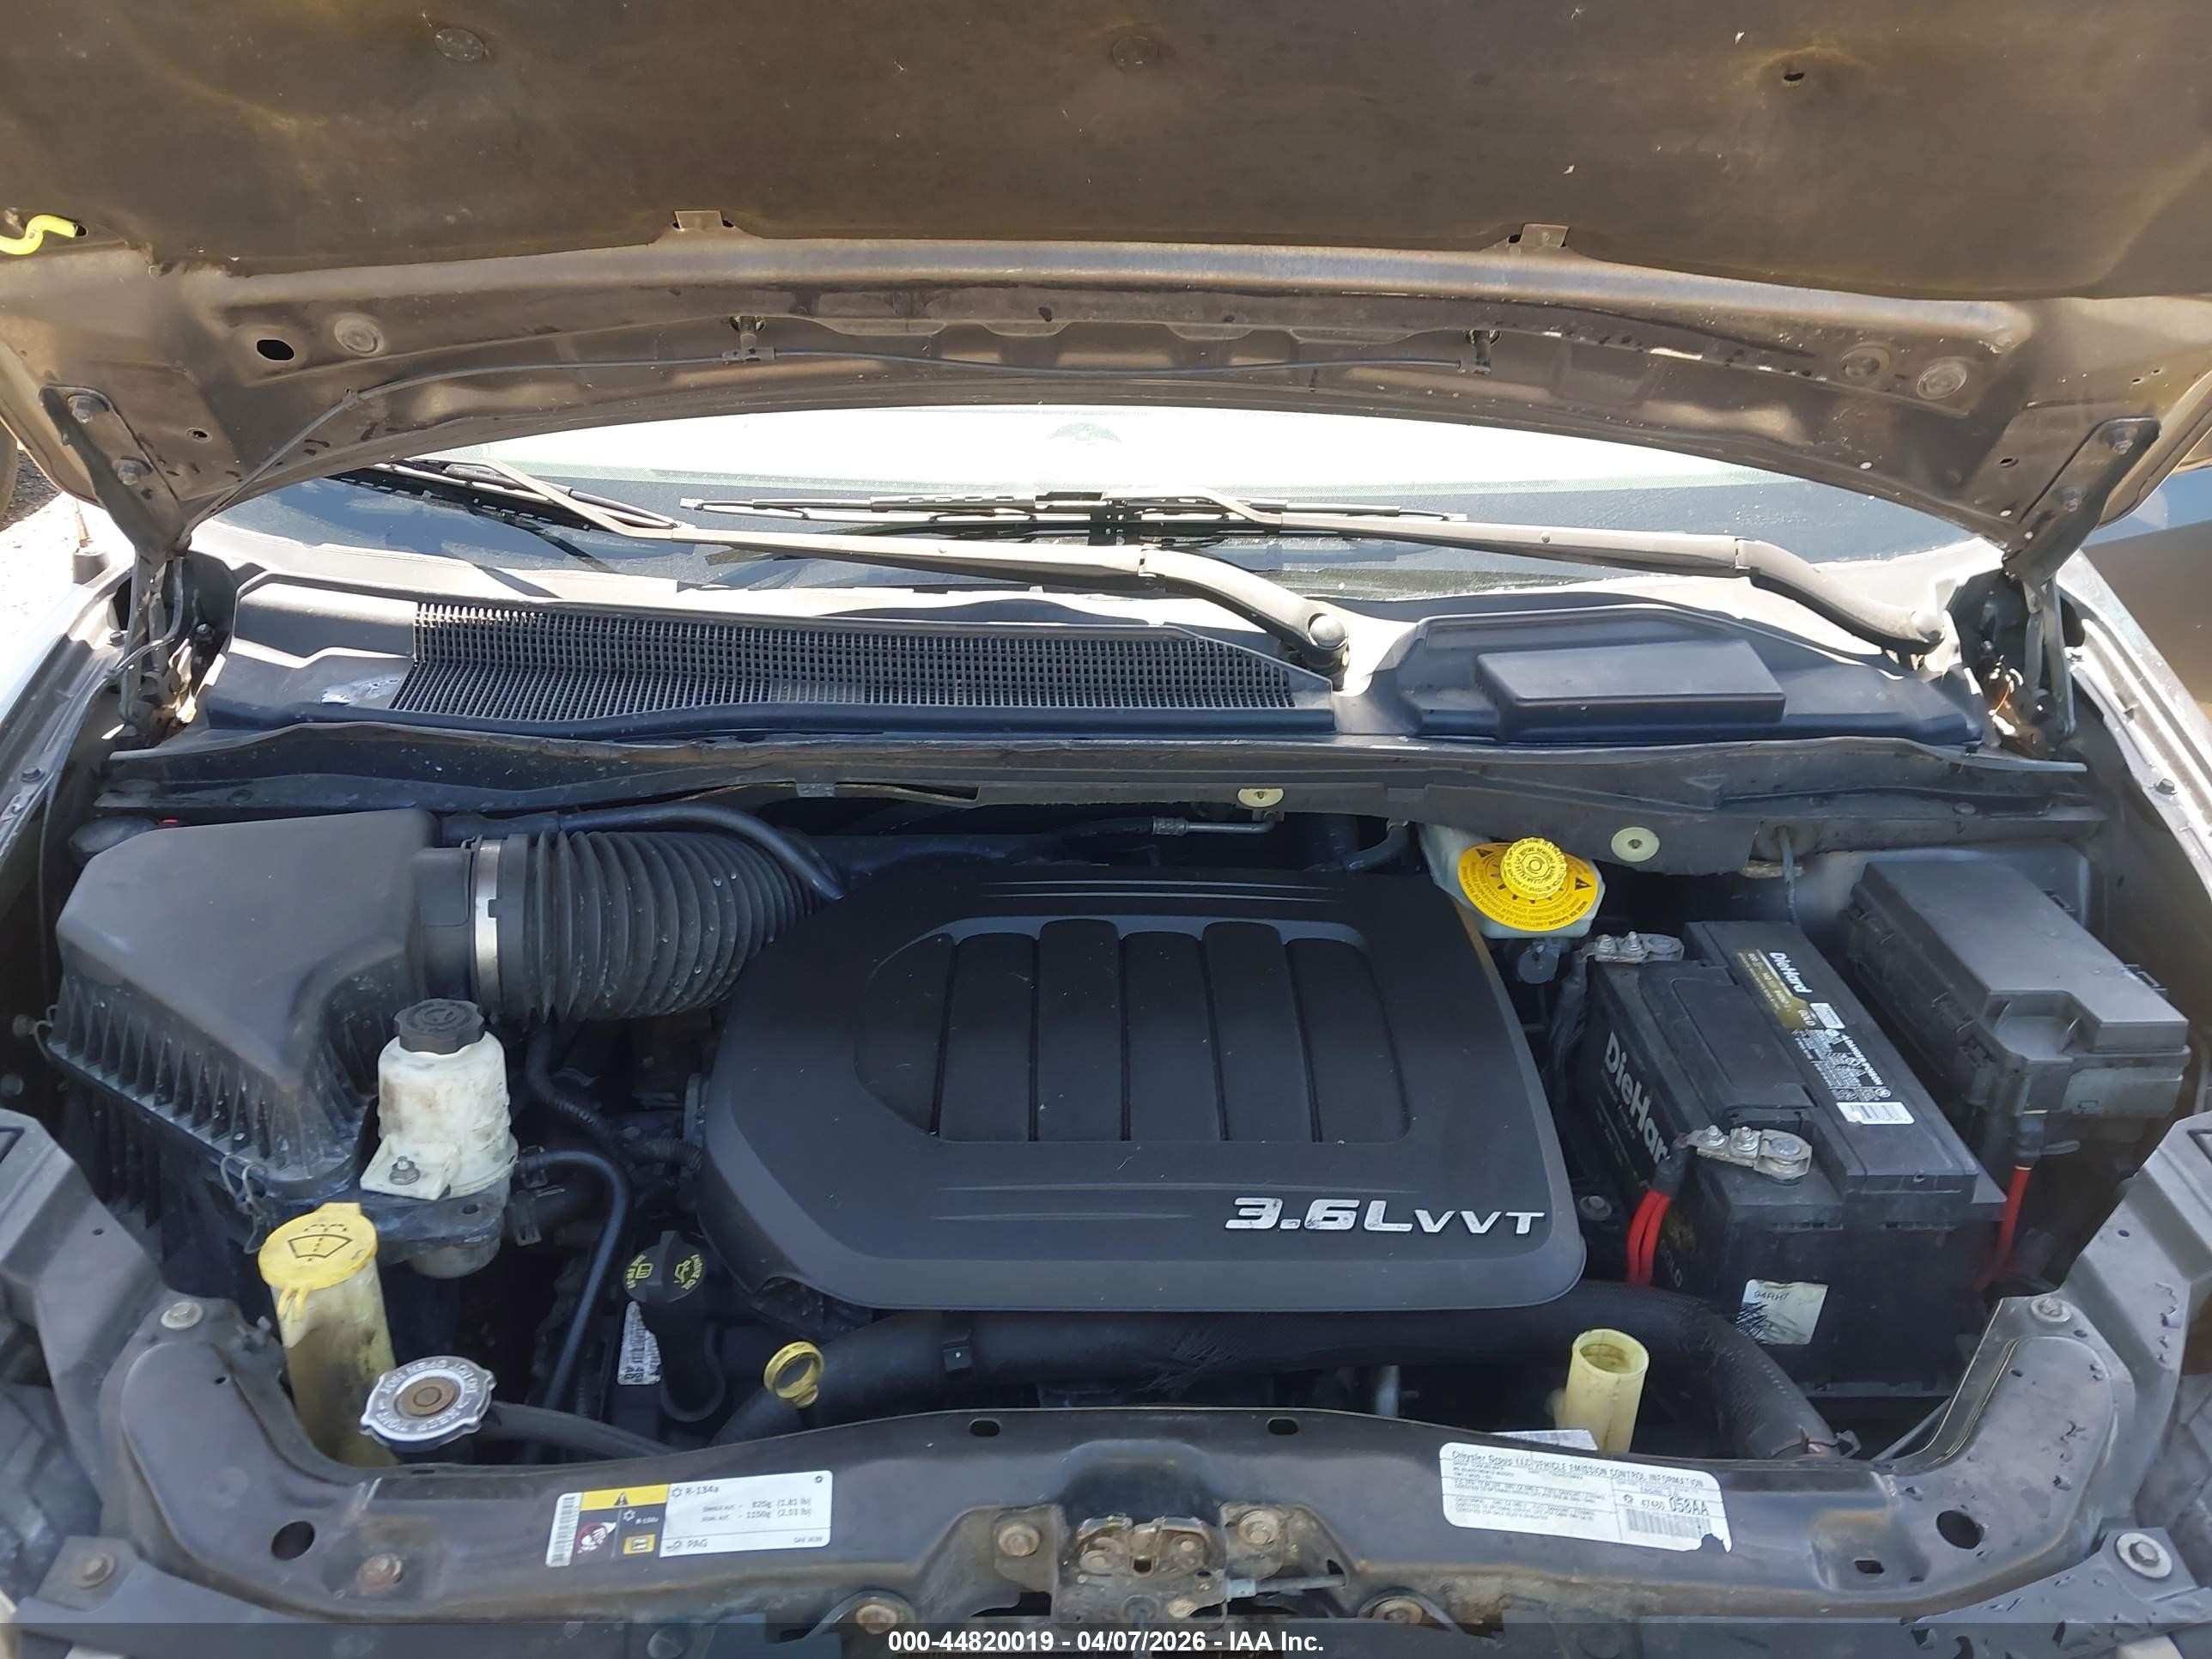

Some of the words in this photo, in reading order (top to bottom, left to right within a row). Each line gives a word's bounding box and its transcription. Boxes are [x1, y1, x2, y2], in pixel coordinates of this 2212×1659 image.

[1769, 951, 1813, 994] DieHard
[1604, 1030, 1668, 1164] DieHar
[687, 1538, 708, 1548] PAG
